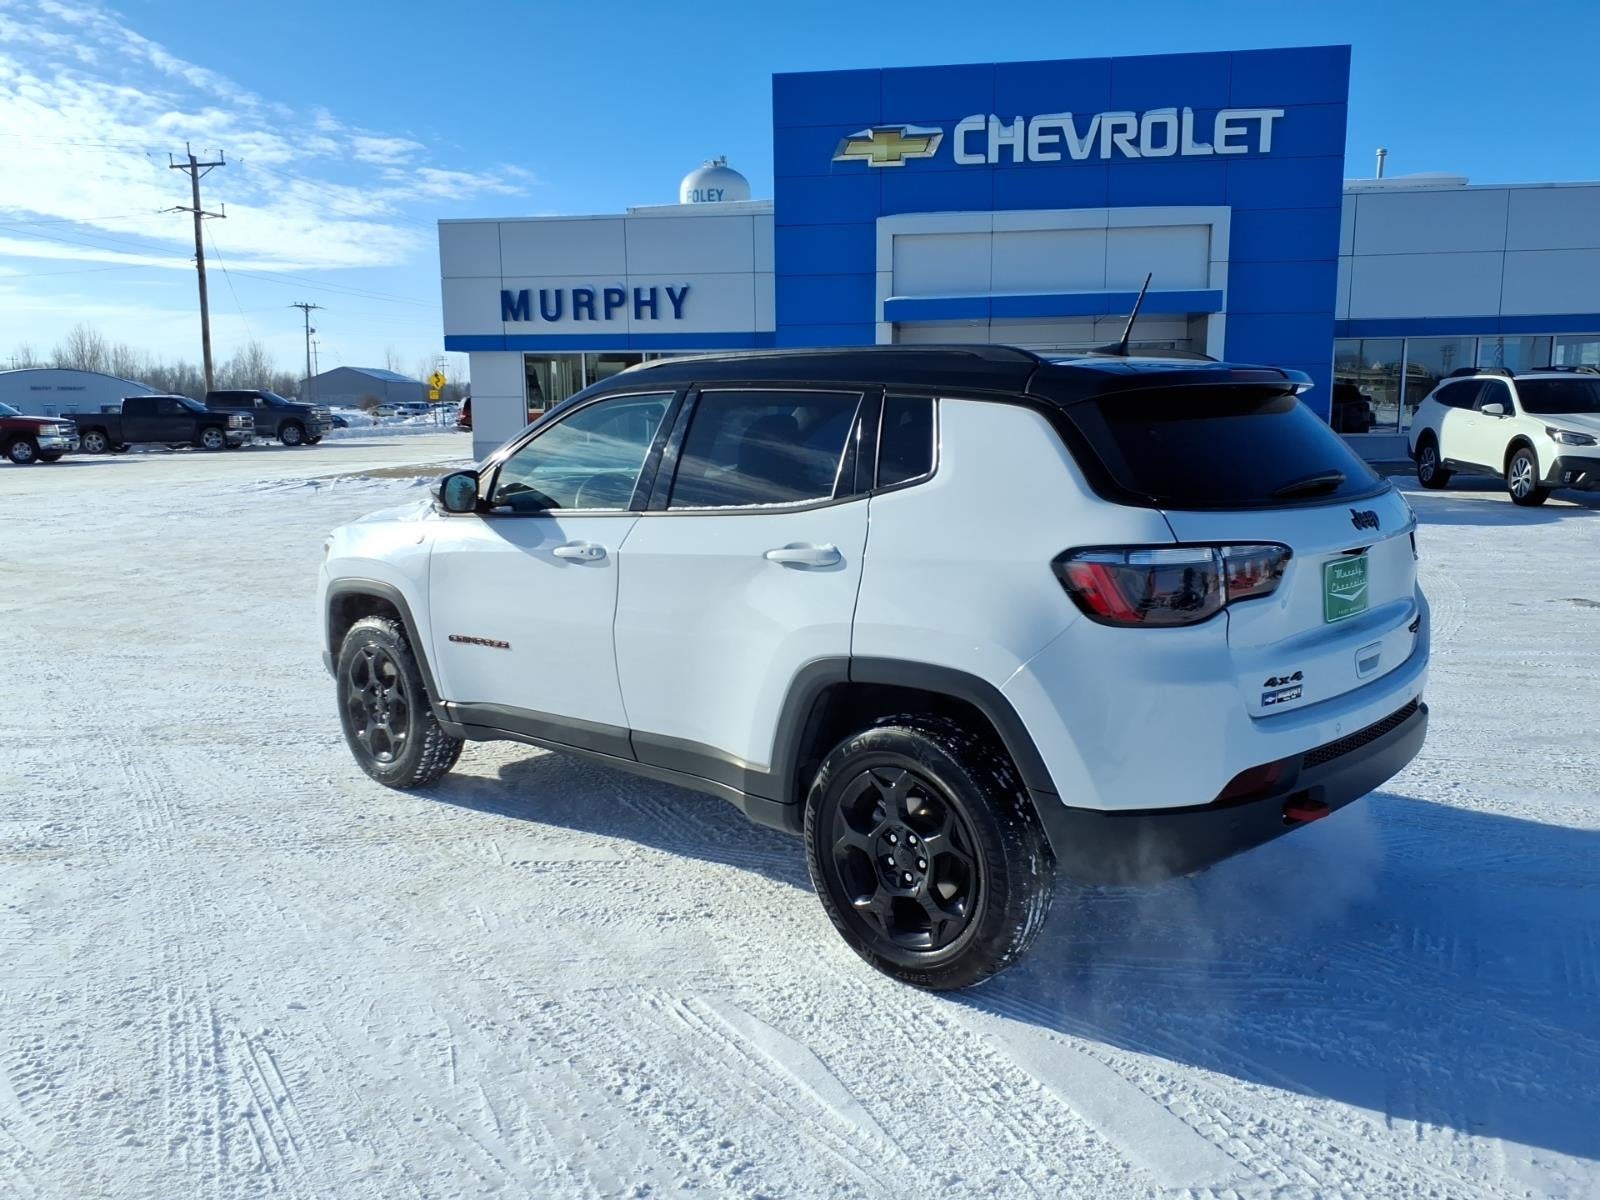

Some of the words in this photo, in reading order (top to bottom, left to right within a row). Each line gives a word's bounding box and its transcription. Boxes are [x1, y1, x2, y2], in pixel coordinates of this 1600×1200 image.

[953, 106, 1285, 165] CHEVROLET
[687, 188, 724, 203] FOLEY
[500, 285, 689, 322] MURPHY
[1350, 508, 1380, 531] Jeep
